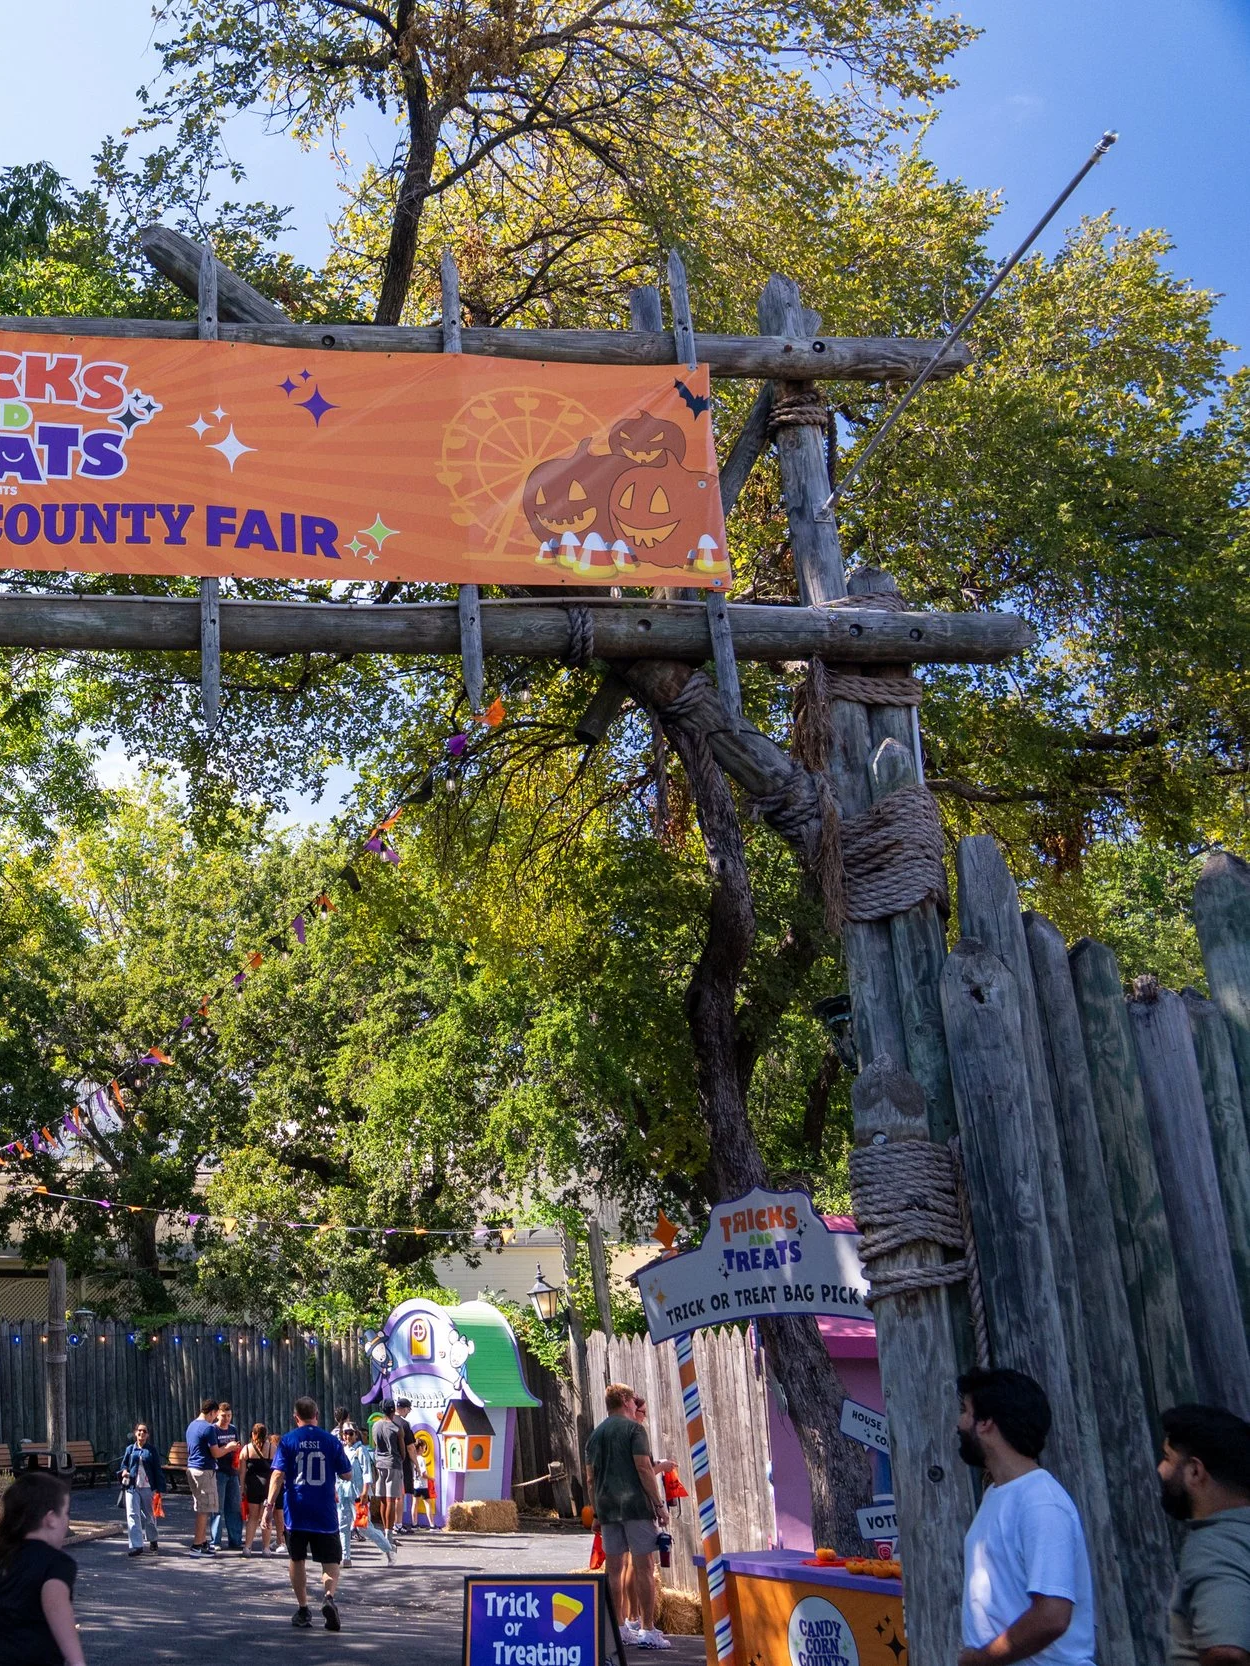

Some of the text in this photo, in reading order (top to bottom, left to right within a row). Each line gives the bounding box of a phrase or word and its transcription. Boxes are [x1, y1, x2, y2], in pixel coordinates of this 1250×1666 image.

[206, 505, 342, 559] FAIR
[719, 1205, 798, 1242] TRICKS
[748, 1233, 774, 1246] AND
[723, 1240, 802, 1272] TREATS
[666, 1298, 705, 1326] TRICK
[711, 1293, 731, 1311] OR
[734, 1286, 777, 1306] TREAT
[784, 1284, 815, 1302] BAG
[852, 1410, 882, 1431] HOUSE
[299, 1441, 320, 1449] MESSI
[875, 1435, 889, 1449] CO
[293, 1451, 326, 1486] 10
[484, 1592, 540, 1618] Trick
[504, 1622, 523, 1636] or
[798, 1619, 842, 1639] CANDY
[493, 1641, 582, 1666] Treating
[805, 1638, 839, 1655] CORN
